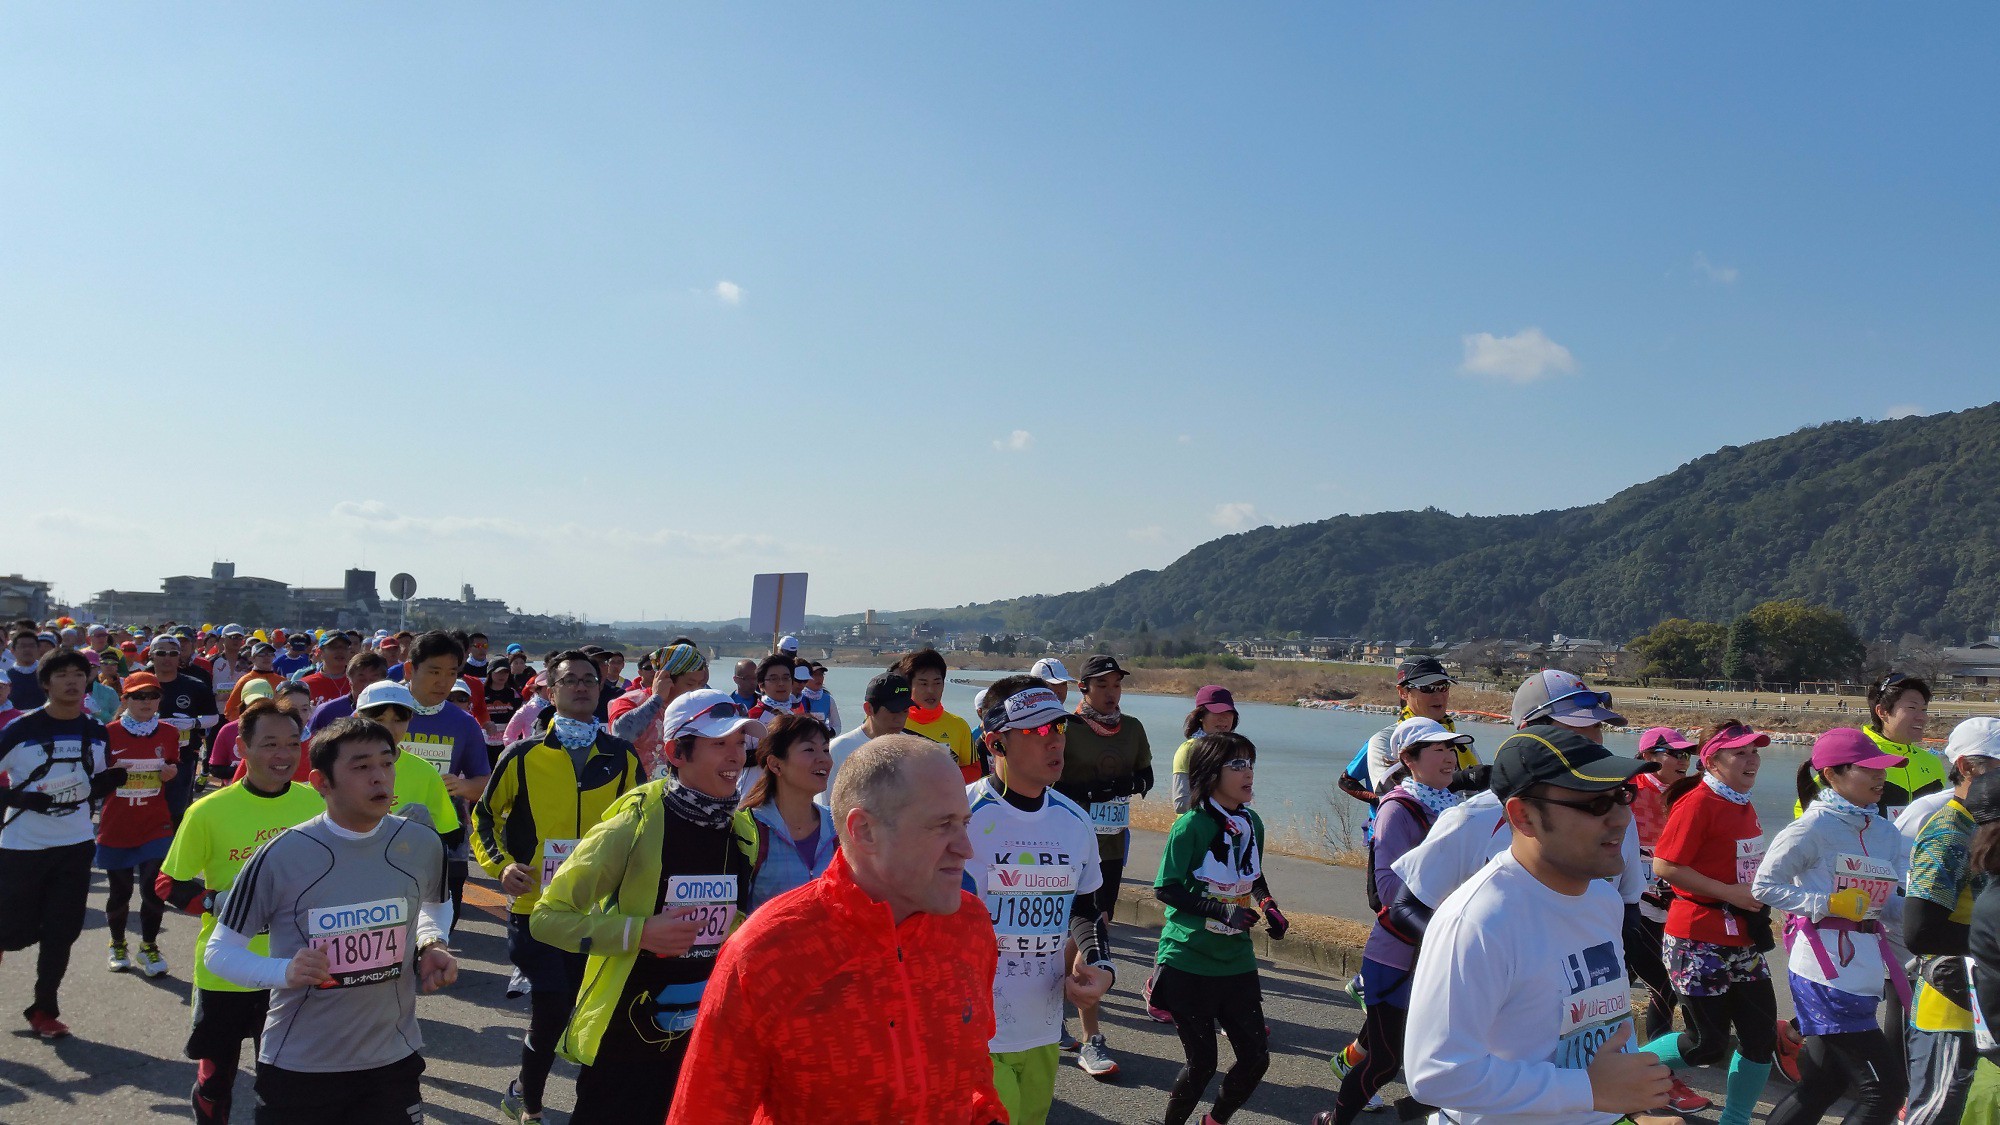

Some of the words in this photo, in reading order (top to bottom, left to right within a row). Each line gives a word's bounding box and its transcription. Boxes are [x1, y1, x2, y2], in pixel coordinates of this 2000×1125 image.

[403, 732, 455, 746] APAN
[37, 747, 64, 757] UER
[1025, 874, 1070, 888] Wacoal
[989, 896, 1065, 928] J18898
[313, 929, 398, 966] 18074
[1588, 992, 1626, 1018] Wacoal
